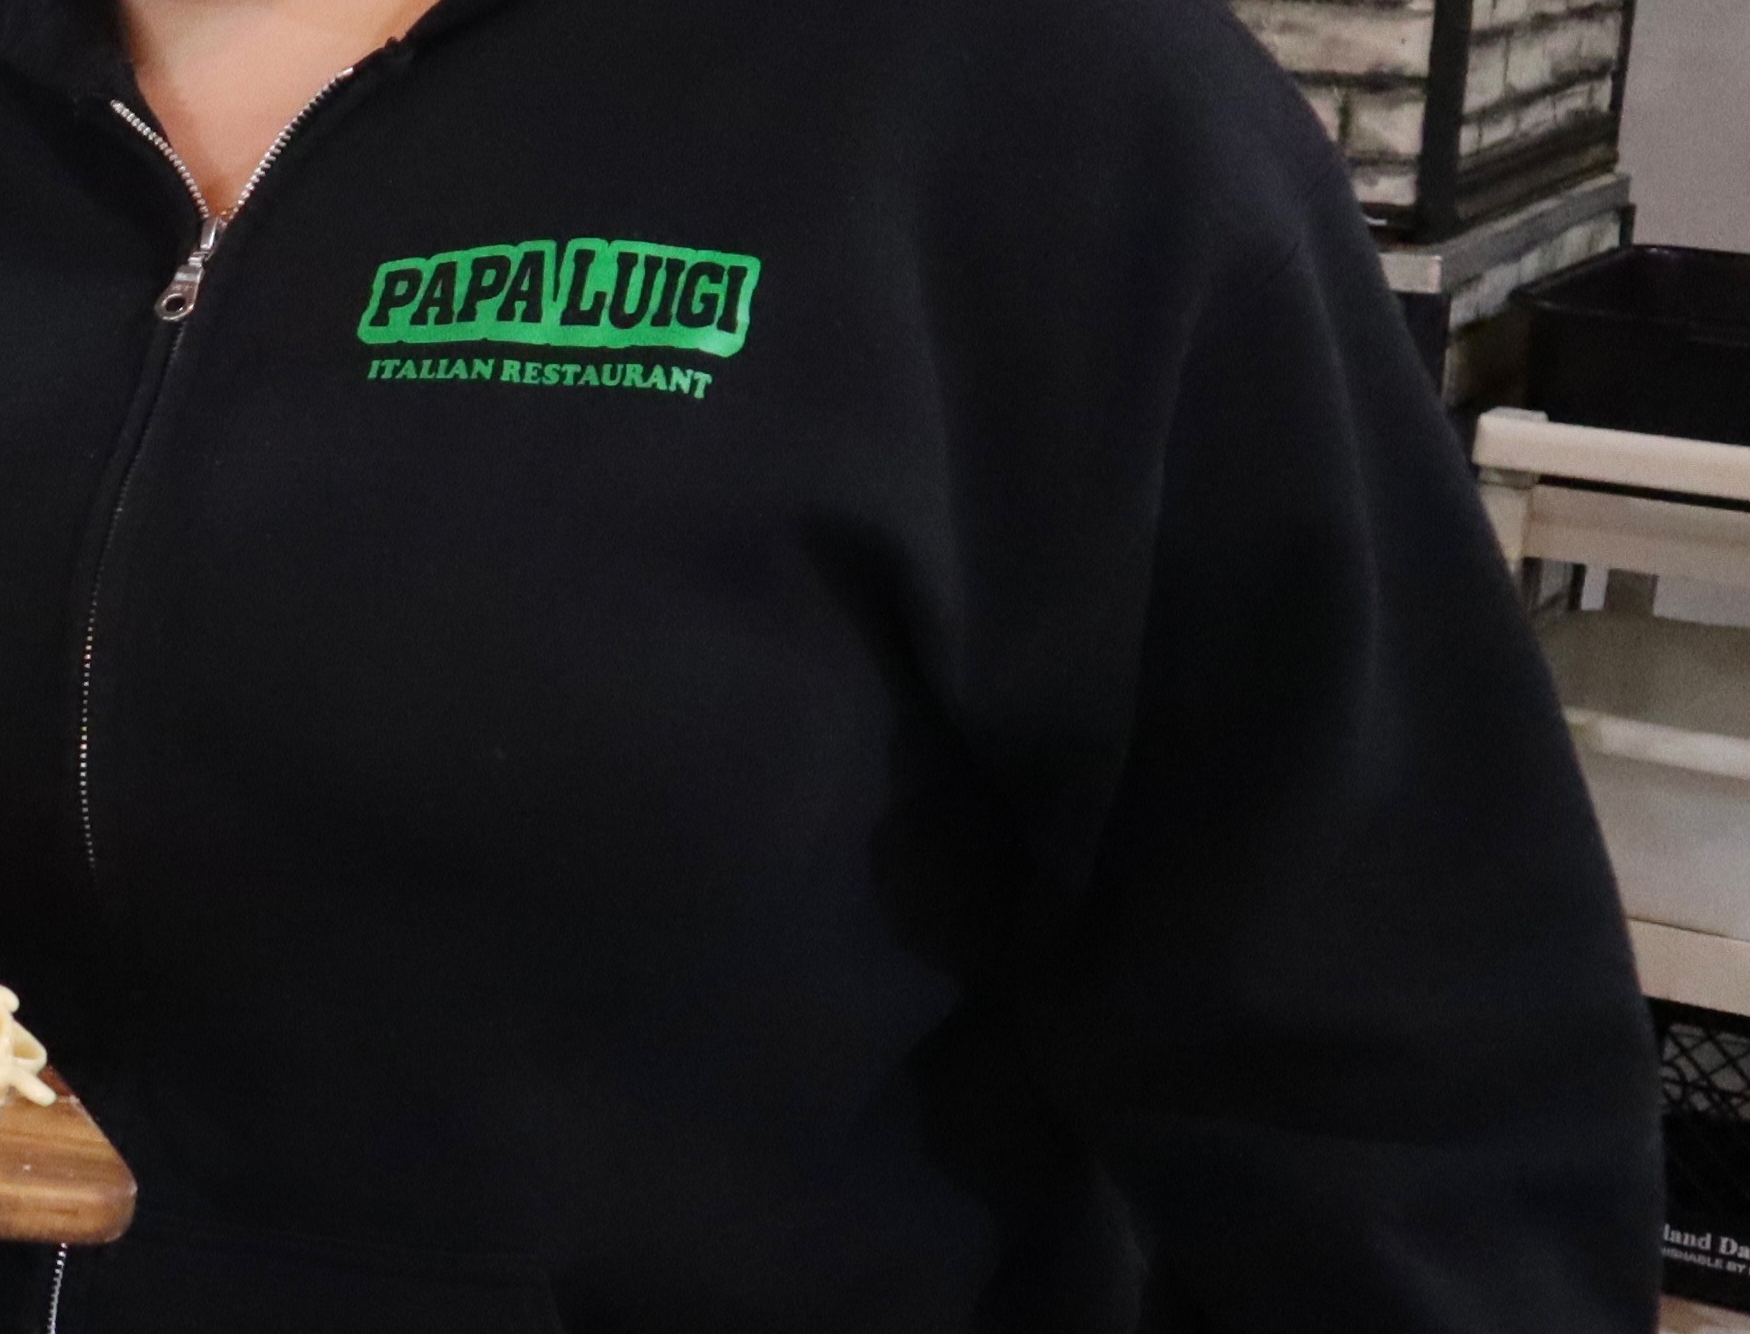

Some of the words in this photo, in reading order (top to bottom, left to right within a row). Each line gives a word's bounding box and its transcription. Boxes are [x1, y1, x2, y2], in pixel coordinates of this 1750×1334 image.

[369, 250, 546, 327] PAPA
[560, 248, 749, 334] LUIGI
[367, 358, 495, 380] ITALIAN
[500, 359, 713, 400] RESTAURANT
[1663, 1223, 1713, 1251] land
[1719, 1236, 1750, 1261] Da
